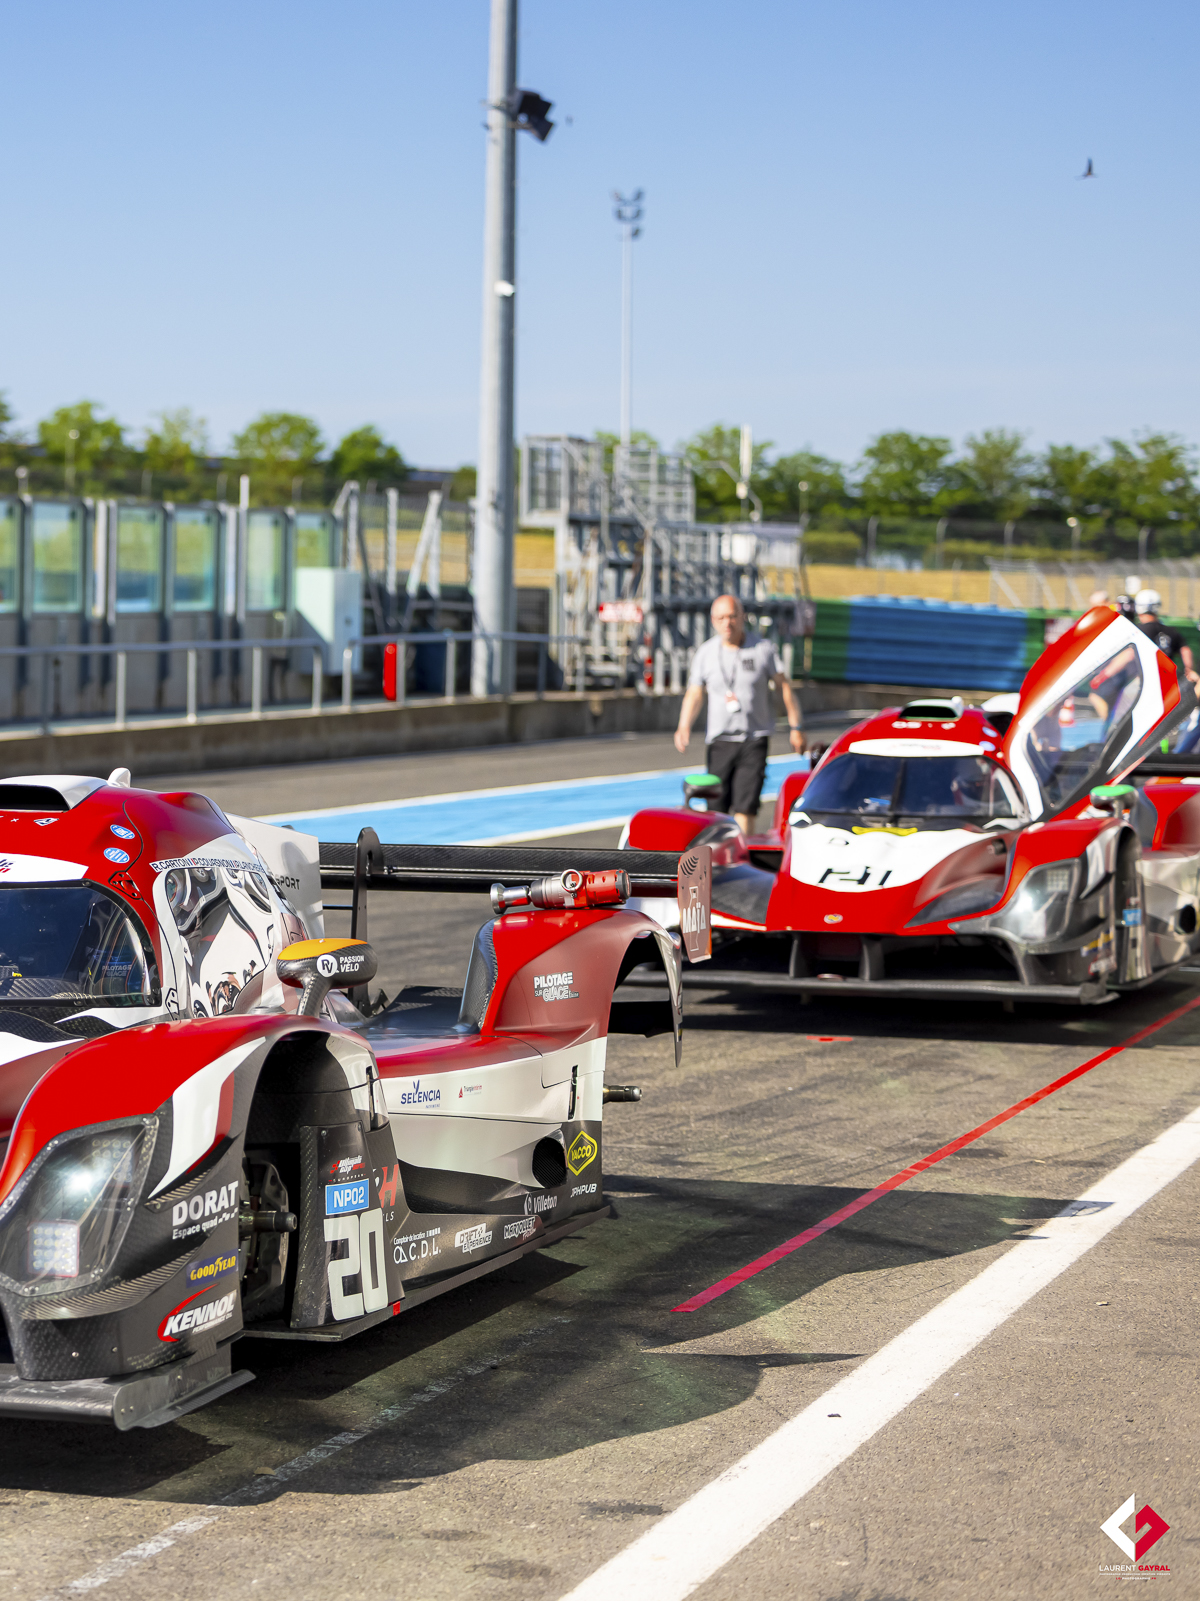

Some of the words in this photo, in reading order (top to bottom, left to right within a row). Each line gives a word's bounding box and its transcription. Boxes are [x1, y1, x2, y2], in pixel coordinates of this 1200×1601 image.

[340, 955, 365, 964] PASSION
[533, 971, 574, 989] PILOTAGE
[542, 985, 569, 1002] GLACE
[400, 1089, 441, 1104] SELENCIA
[571, 1145, 592, 1161] YACCO
[172, 1181, 239, 1227] DORAT
[333, 1186, 365, 1208] NP02
[534, 1195, 558, 1213] Villeton
[172, 1223, 200, 1240] Espace
[201, 1215, 219, 1233] quad
[463, 1235, 492, 1251] EXPERIENCE
[323, 1207, 389, 1321] 20
[163, 1290, 237, 1337] KENNOL
